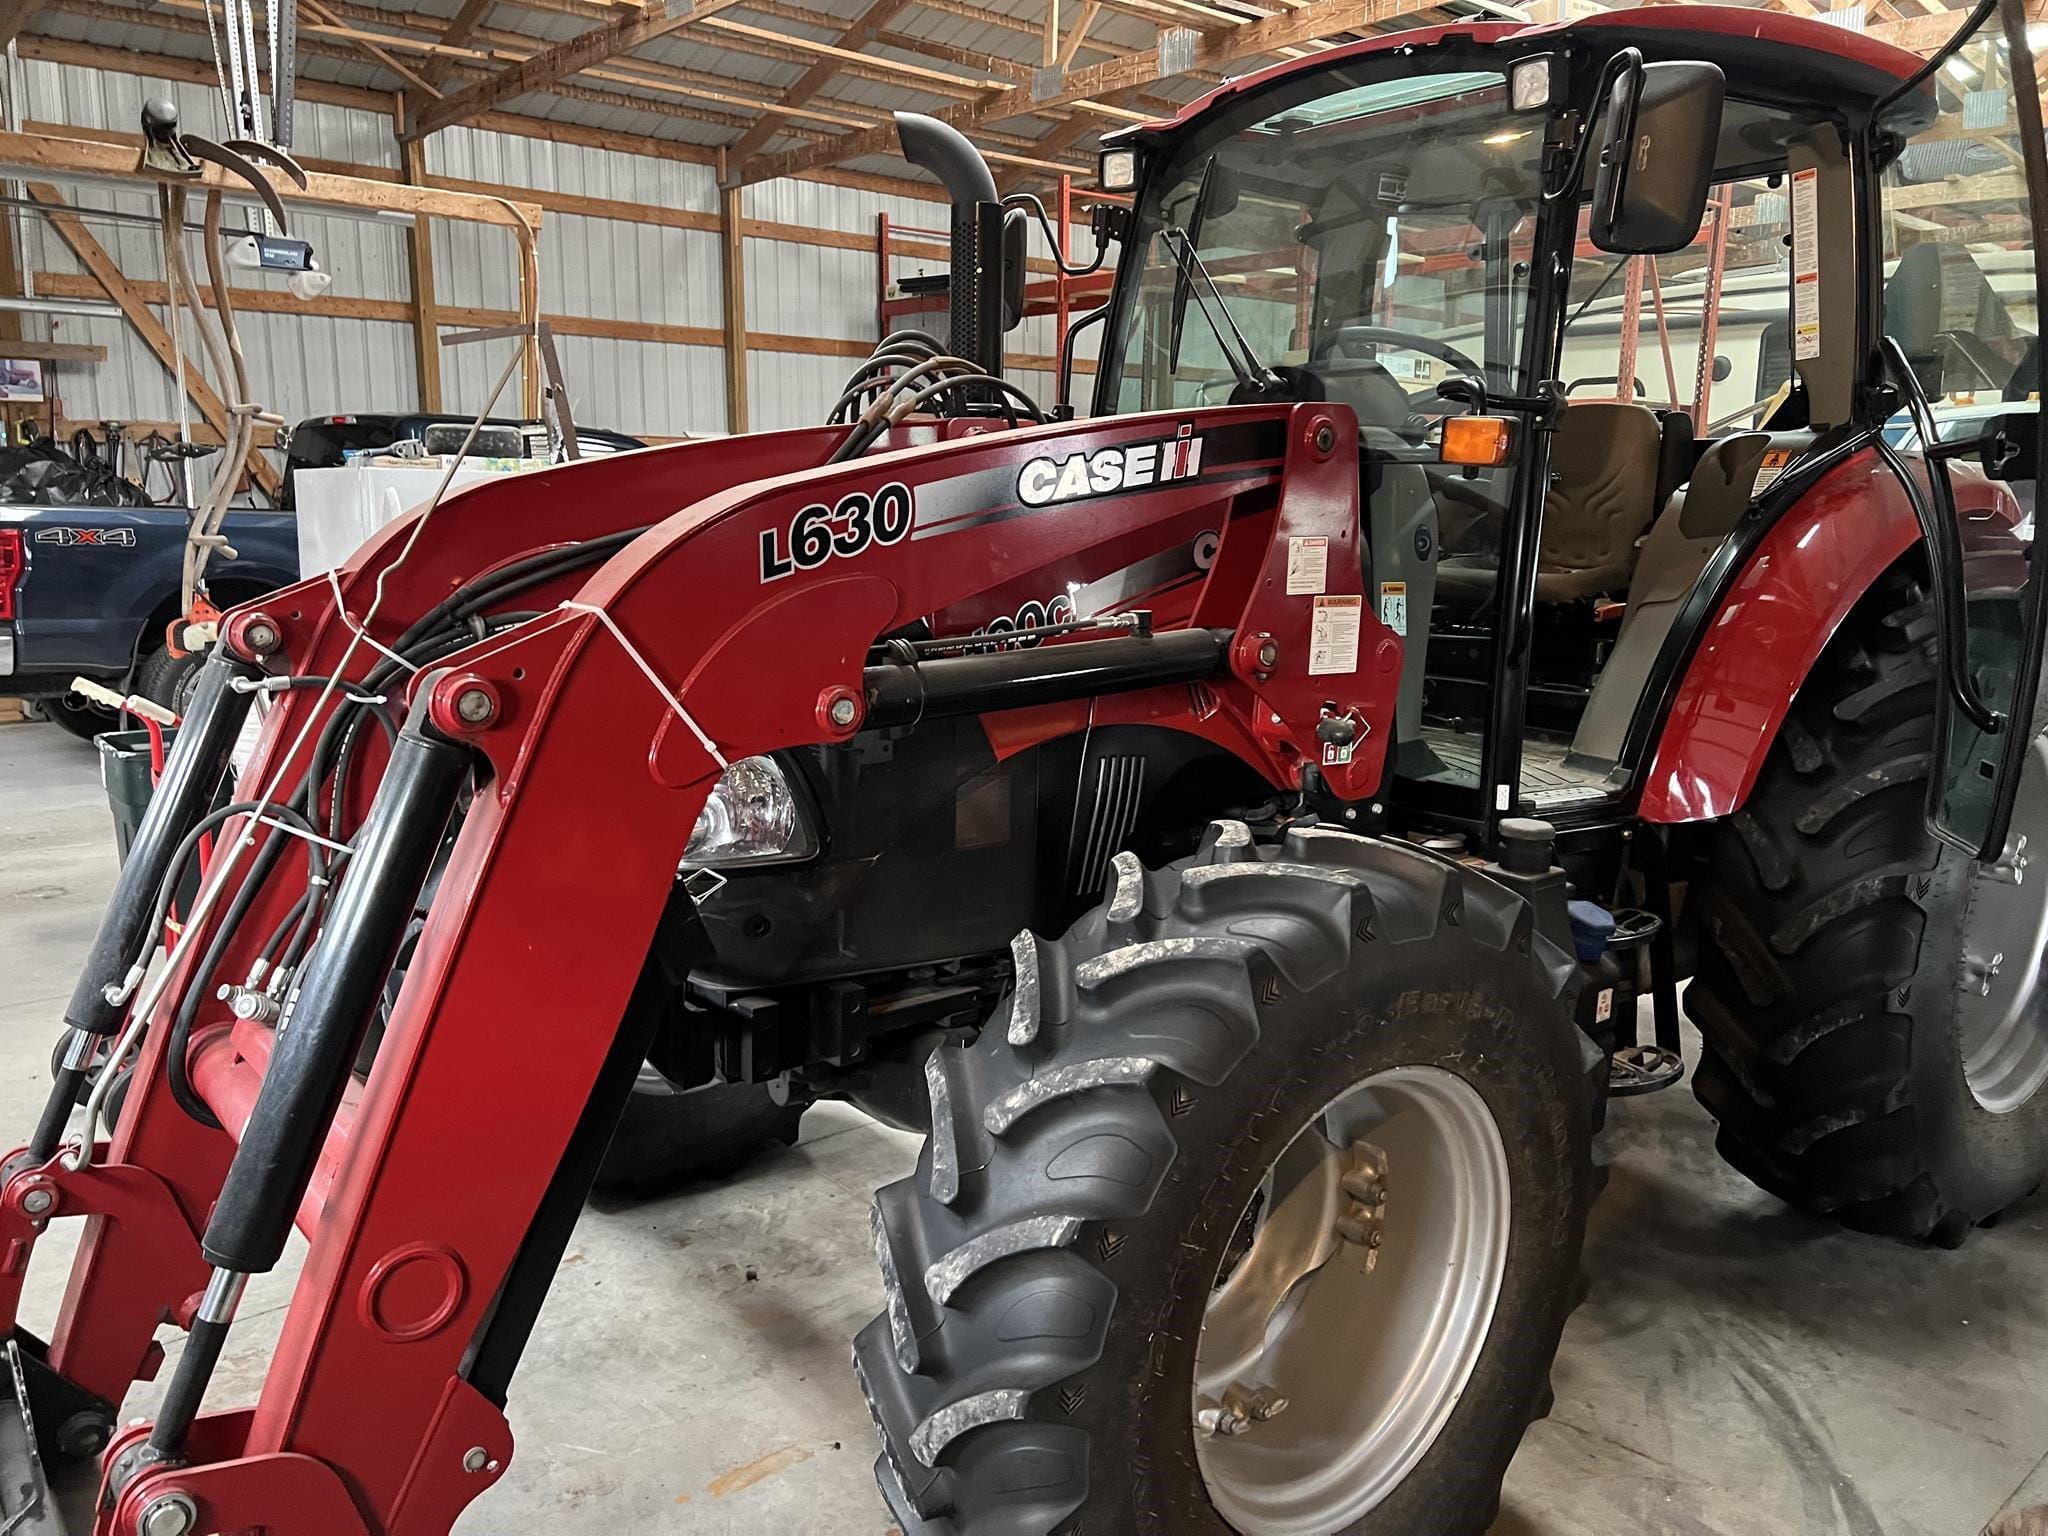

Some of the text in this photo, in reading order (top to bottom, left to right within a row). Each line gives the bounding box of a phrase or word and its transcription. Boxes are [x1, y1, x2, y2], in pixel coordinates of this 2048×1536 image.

[1017, 448, 1157, 505] CASE
[760, 482, 912, 584] L630
[1327, 598, 1358, 606] WARNING
